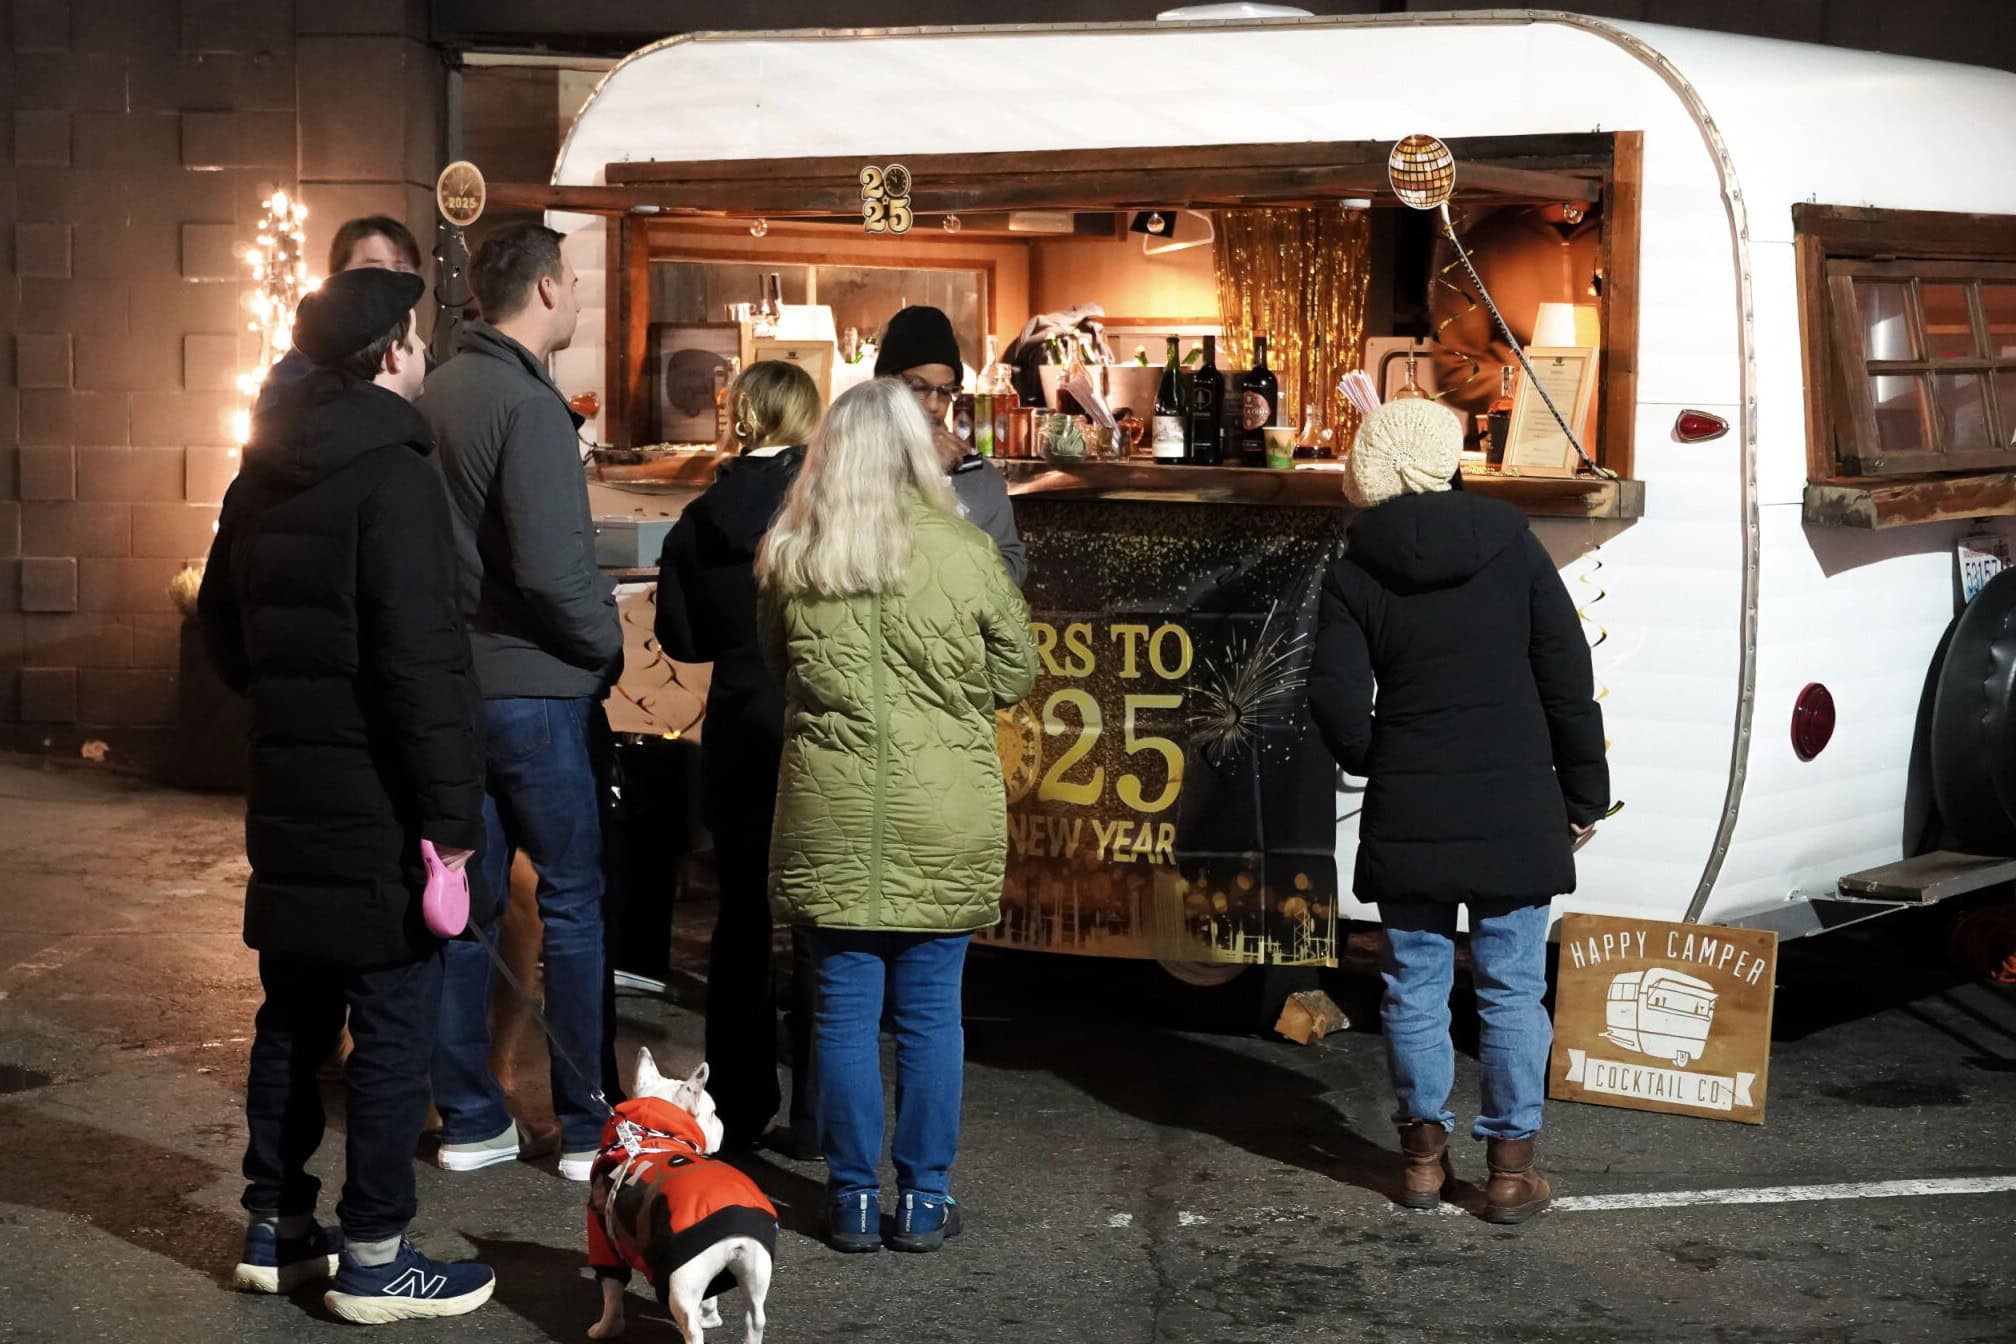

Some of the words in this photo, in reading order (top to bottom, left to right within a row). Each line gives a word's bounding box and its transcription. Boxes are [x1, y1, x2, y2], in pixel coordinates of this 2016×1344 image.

[448, 197, 476, 209] 2025
[1031, 622, 1096, 678] RS
[1110, 623, 1194, 680] TO
[1008, 814, 1082, 861] NEW
[1091, 819, 1177, 866] YEAR
[1570, 931, 1647, 969] HAPPY
[1666, 930, 1766, 986] CAMPER
[1596, 1064, 1684, 1099] COCKTAIL
